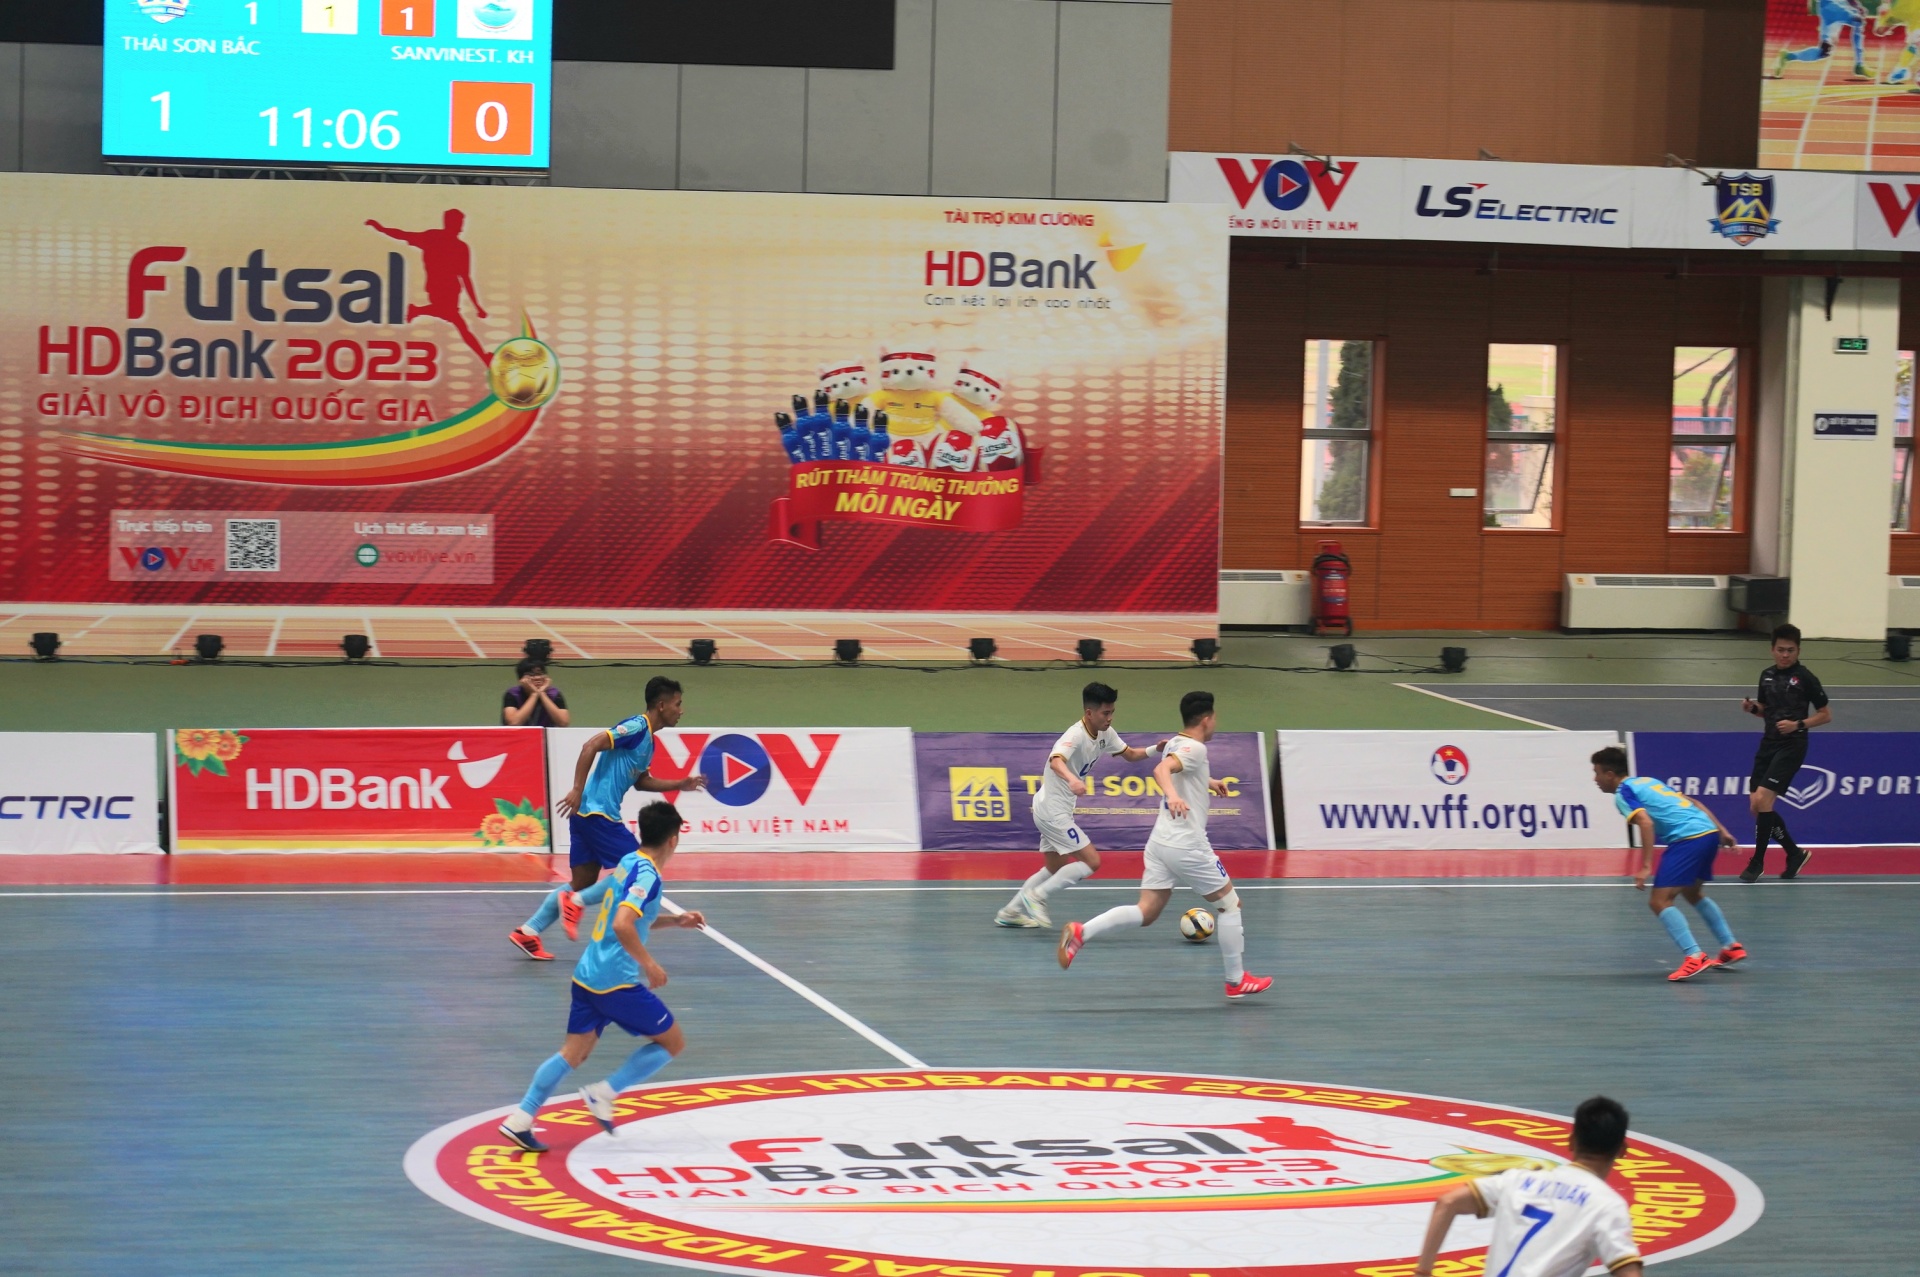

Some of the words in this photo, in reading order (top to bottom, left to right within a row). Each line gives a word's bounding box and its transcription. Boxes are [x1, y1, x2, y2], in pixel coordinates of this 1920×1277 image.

[245, 1, 258, 25] 1
[400, 6, 414, 31] 1
[173, 37, 216, 53] SƠN
[507, 50, 534, 64] KH
[150, 90, 172, 132] 1
[474, 101, 509, 143] 0
[258, 106, 401, 151] 11:06
[1415, 184, 1474, 218] LS
[1475, 199, 1619, 225] ELECTRIC
[1728, 182, 1764, 197] TSB
[944, 208, 969, 224] TÀI
[972, 210, 1005, 227] TRỢ
[1008, 213, 1036, 225] KIM
[1261, 216, 1287, 230] NÓI
[1292, 218, 1323, 233] VIỆT
[1327, 220, 1359, 231] NAM
[127, 245, 405, 325] Futsal
[924, 250, 1098, 290] HDBank
[38, 325, 276, 380] HDBank
[287, 339, 438, 381] 2023
[37, 386, 107, 417] GIẢI
[120, 389, 165, 418] VÔ
[178, 395, 257, 424] ĐỊCH
[271, 388, 364, 422] QUỐC
[376, 398, 434, 422] GIA
[795, 466, 834, 488] RÚT
[836, 463, 888, 486] THĂM
[889, 470, 946, 494] TRÚNG
[947, 474, 1020, 496] THƯỞNG
[834, 487, 888, 514] MỖI
[889, 494, 962, 521] NGÀY
[118, 547, 189, 571] VOV
[246, 767, 453, 811] HDBank
[956, 799, 1005, 818] TSB
[1319, 793, 1590, 838] www.vff.org.vn
[701, 815, 740, 834] NÓI
[747, 815, 794, 838] VIỆT
[803, 819, 850, 834] NAM
[1067, 827, 1081, 845] 9
[801, 1074, 1171, 1092] HDBANK
[1181, 1081, 1412, 1110] 2023
[728, 1132, 1247, 1163] Futsal
[591, 1161, 1045, 1187] HDBank
[1052, 1158, 1340, 1177] 2023
[769, 1184, 859, 1197] VÔ
[881, 1181, 1034, 1195] ĐỊCH
[1056, 1175, 1236, 1191] QUỐC
[1255, 1176, 1363, 1187] GIA
[1496, 1203, 1554, 1277] 7
